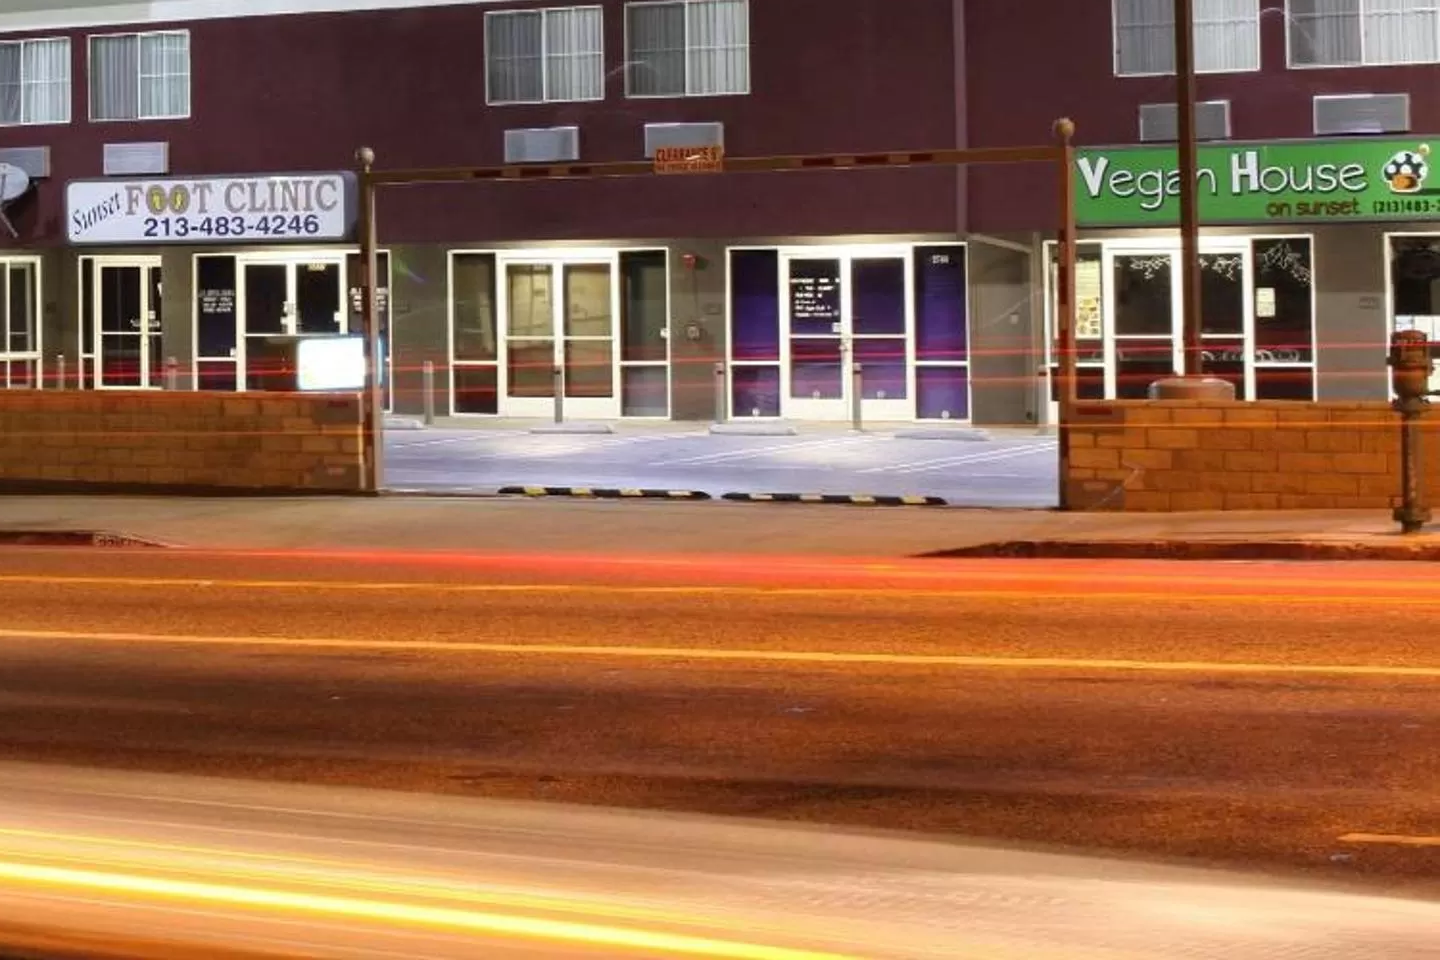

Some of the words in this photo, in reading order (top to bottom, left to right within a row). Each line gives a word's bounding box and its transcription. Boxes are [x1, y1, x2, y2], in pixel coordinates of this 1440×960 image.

[1231, 151, 1368, 193] House
[72, 192, 121, 235] Sunset
[125, 182, 212, 215] FOOT
[224, 179, 337, 213] CLINIC
[1266, 201, 1291, 217] on
[1296, 197, 1360, 216] sunset
[144, 214, 320, 237] 213-483-4246
